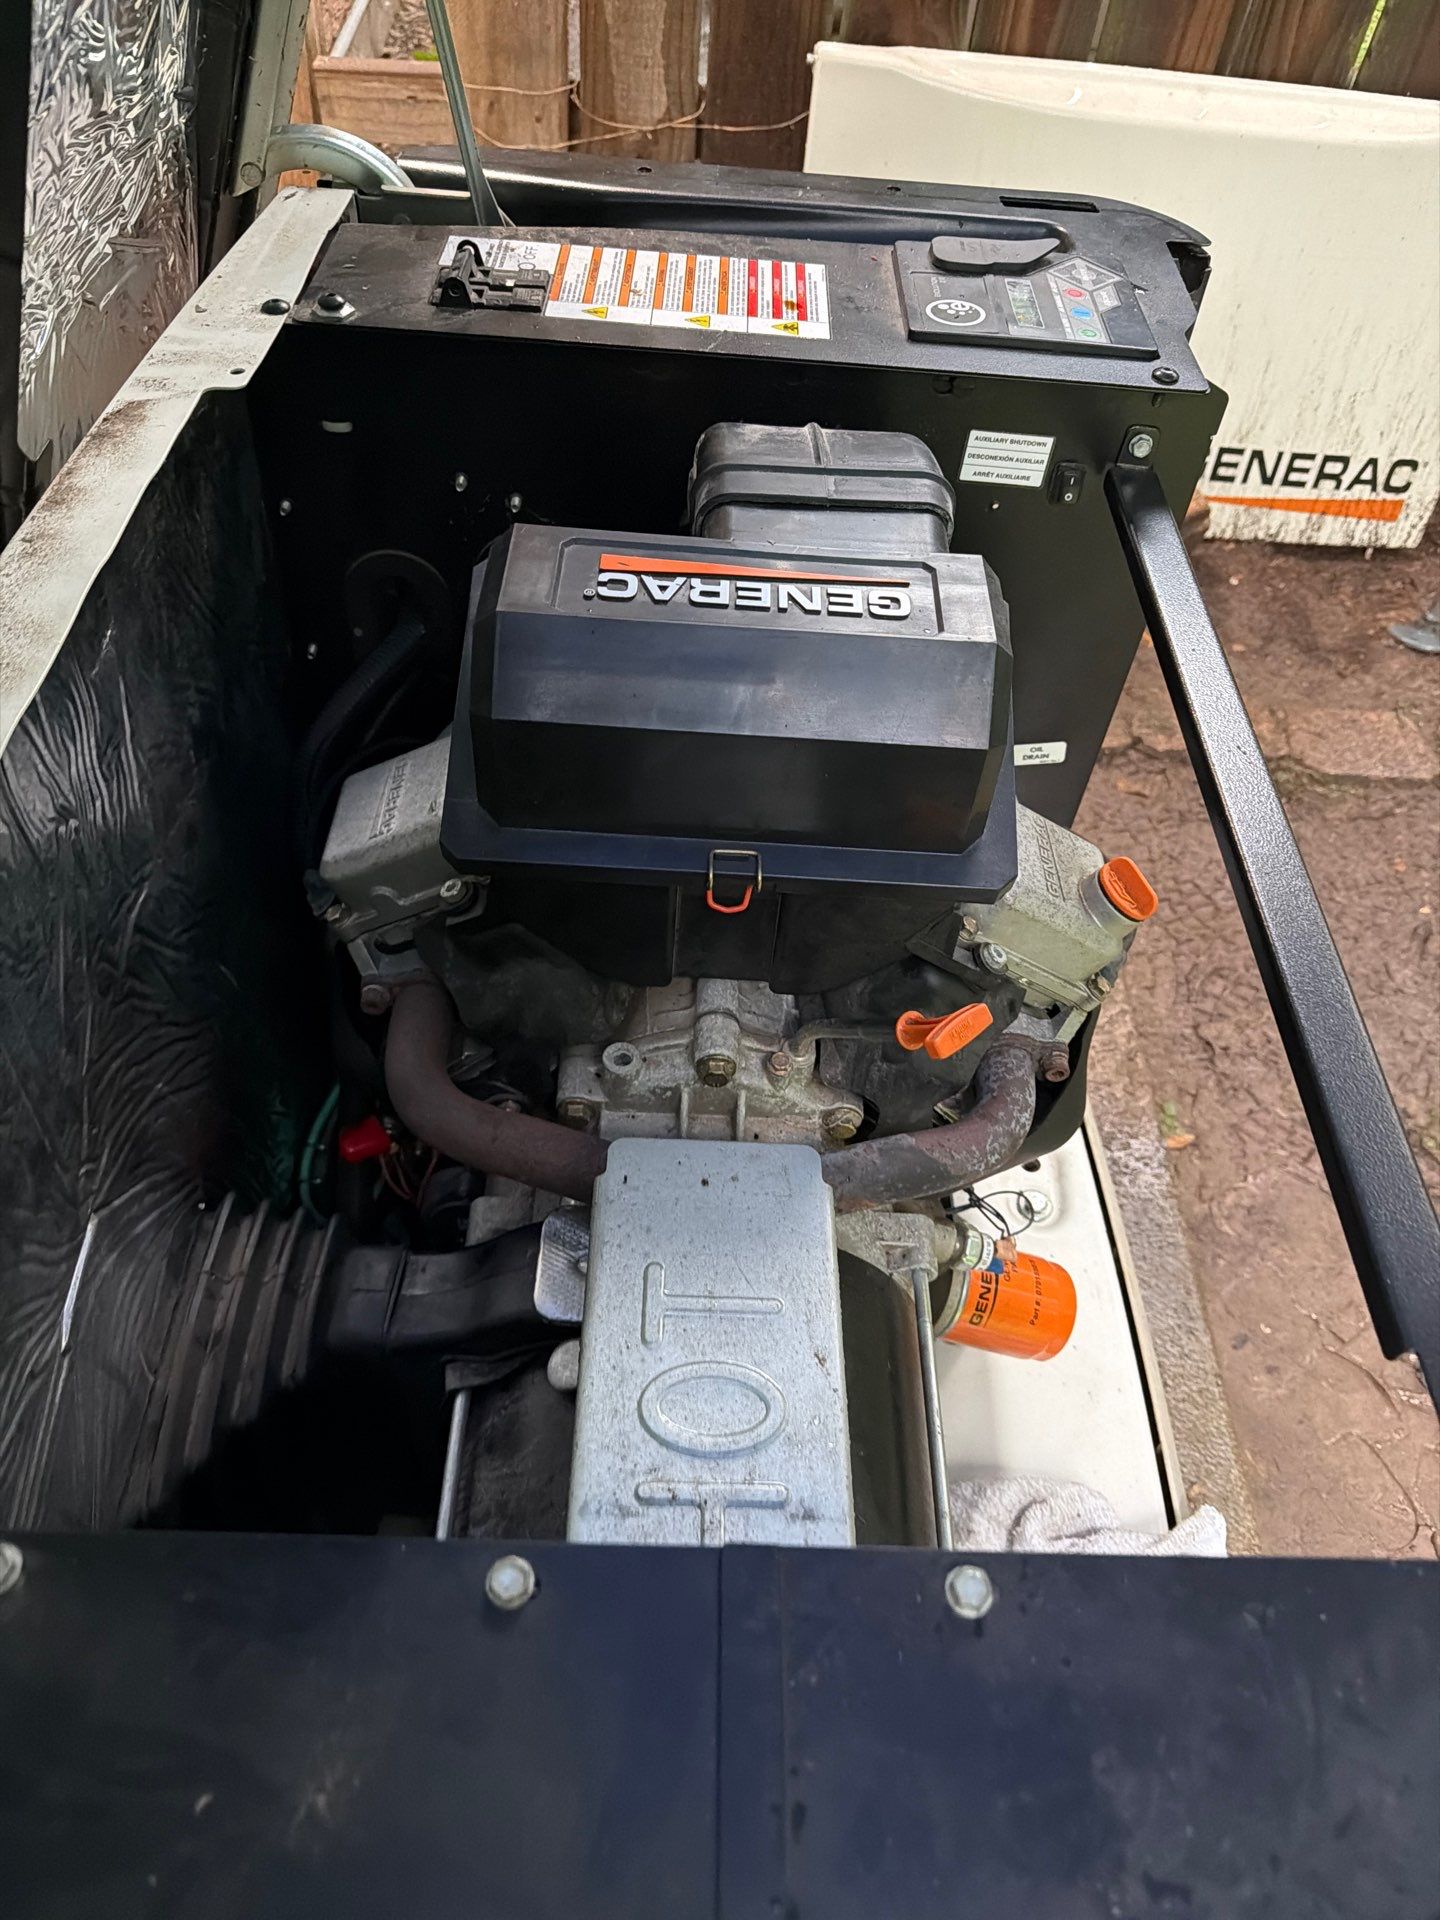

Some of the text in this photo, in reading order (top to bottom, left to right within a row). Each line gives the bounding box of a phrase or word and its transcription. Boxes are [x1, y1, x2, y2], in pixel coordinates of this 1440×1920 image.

[974, 435, 1047, 448] AUXILIARY SHUTDOWN
[967, 452, 1045, 466] DESCONEXIÓN AUXILIAR
[1203, 447, 1418, 494] ENERAC
[972, 470, 1031, 482] ARRÊT AUXILIAIRE
[1022, 753, 1050, 761] DRAIN
[1031, 817, 1060, 899] GENERAC
[968, 1271, 993, 1327] GENE
[637, 1261, 791, 1548] HOT
